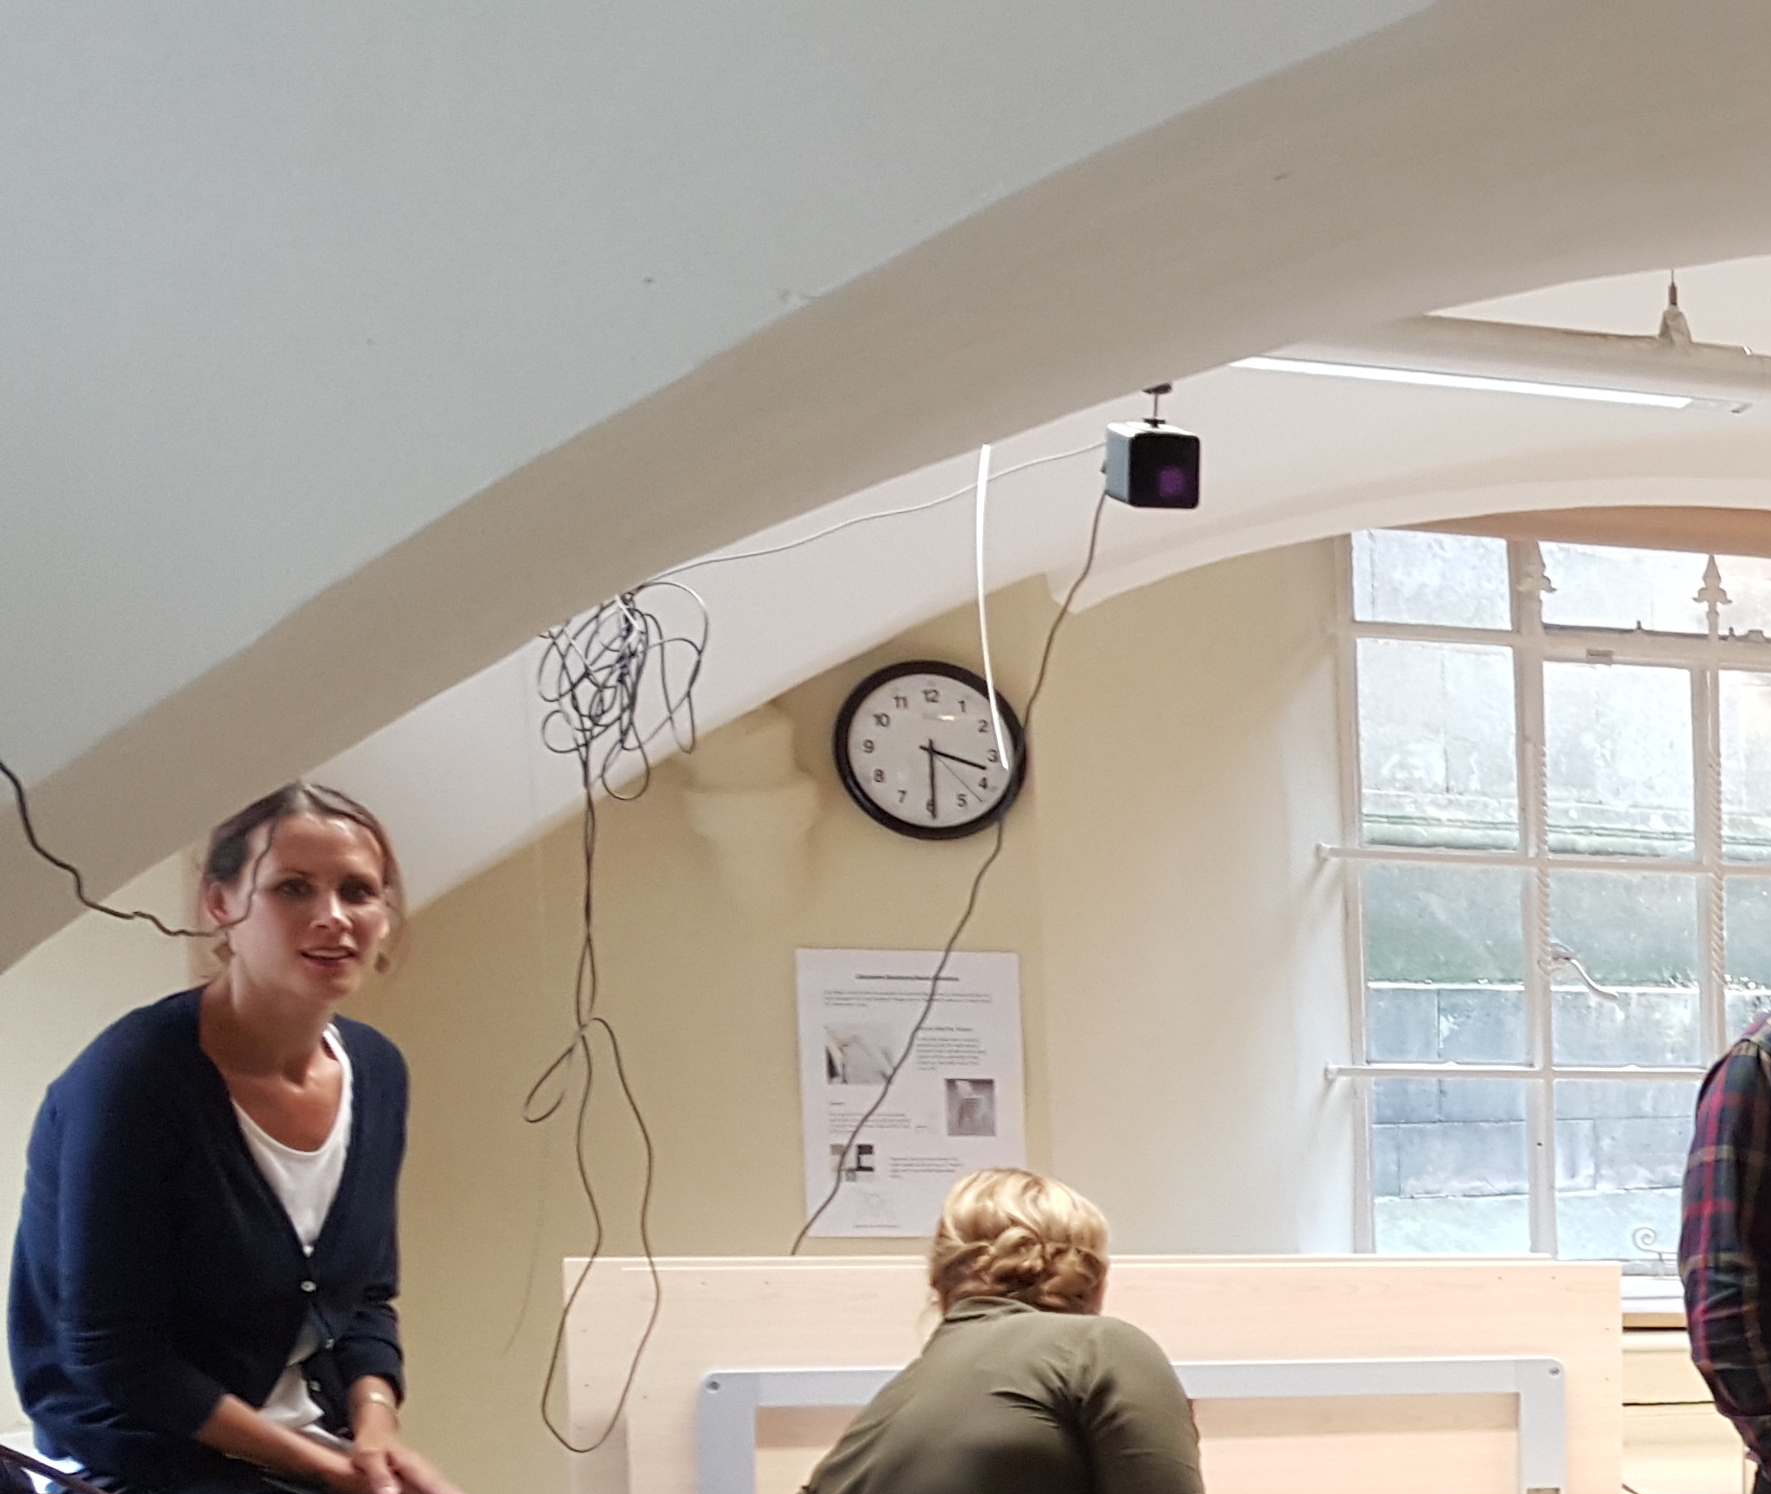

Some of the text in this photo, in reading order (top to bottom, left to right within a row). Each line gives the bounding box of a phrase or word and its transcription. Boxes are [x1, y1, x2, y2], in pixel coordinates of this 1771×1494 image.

[893, 695, 909, 710] 11
[922, 689, 940, 703] 12
[958, 700, 967, 713] 1
[873, 712, 891, 728] 10
[978, 719, 988, 734] 2
[862, 739, 875, 754] 9
[987, 749, 998, 763] 3
[873, 768, 885, 783] 8
[978, 776, 988, 790] 4
[897, 789, 907, 804] 7
[957, 793, 968, 808] 5
